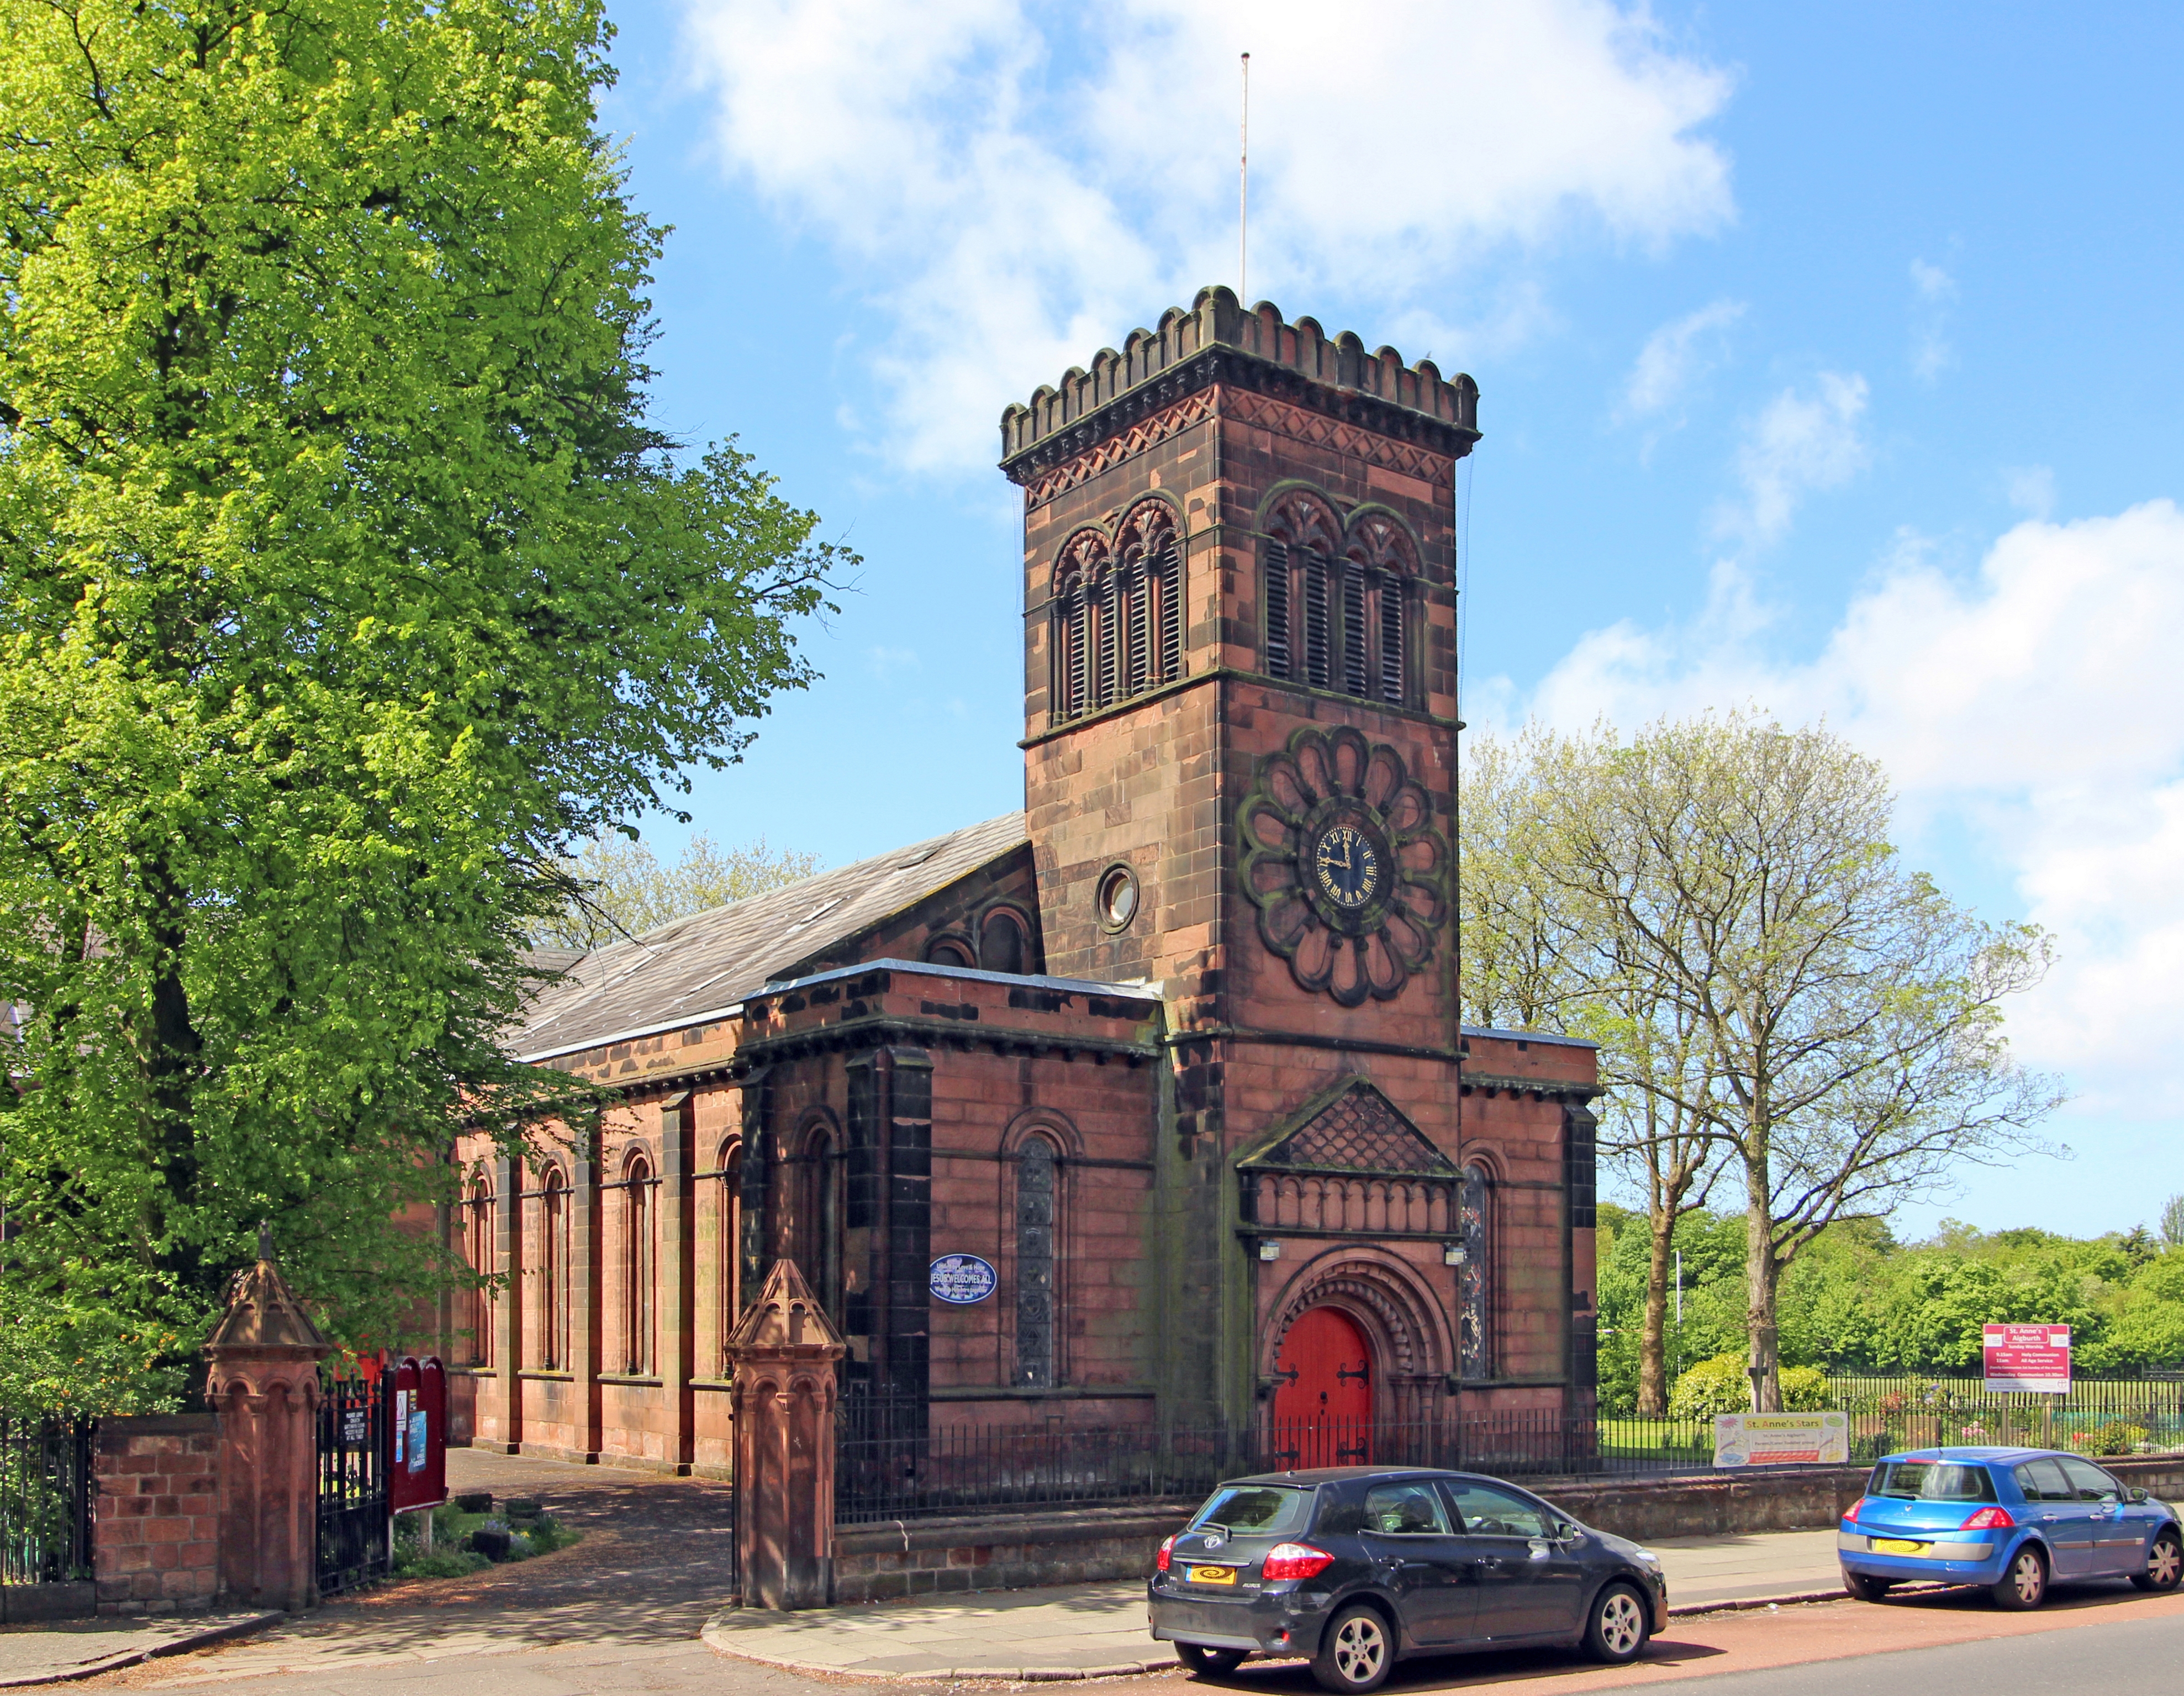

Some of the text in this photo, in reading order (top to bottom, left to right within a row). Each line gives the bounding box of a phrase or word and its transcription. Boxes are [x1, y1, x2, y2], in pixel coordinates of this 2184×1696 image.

[1330, 831, 1340, 844] XI
[1342, 830, 1352, 842] XII
[1356, 837, 1361, 846] I
[1322, 842, 1331, 852] X
[1363, 850, 1371, 860] II
[1365, 866, 1374, 875] III
[1321, 870, 1332, 887] VIII
[1362, 878, 1372, 892] IIII
[1330, 884, 1341, 899] VII
[1355, 890, 1363, 901] V
[1345, 892, 1353, 903] VI
[931, 1273, 992, 1285] JESUS WELCOMES ALL
